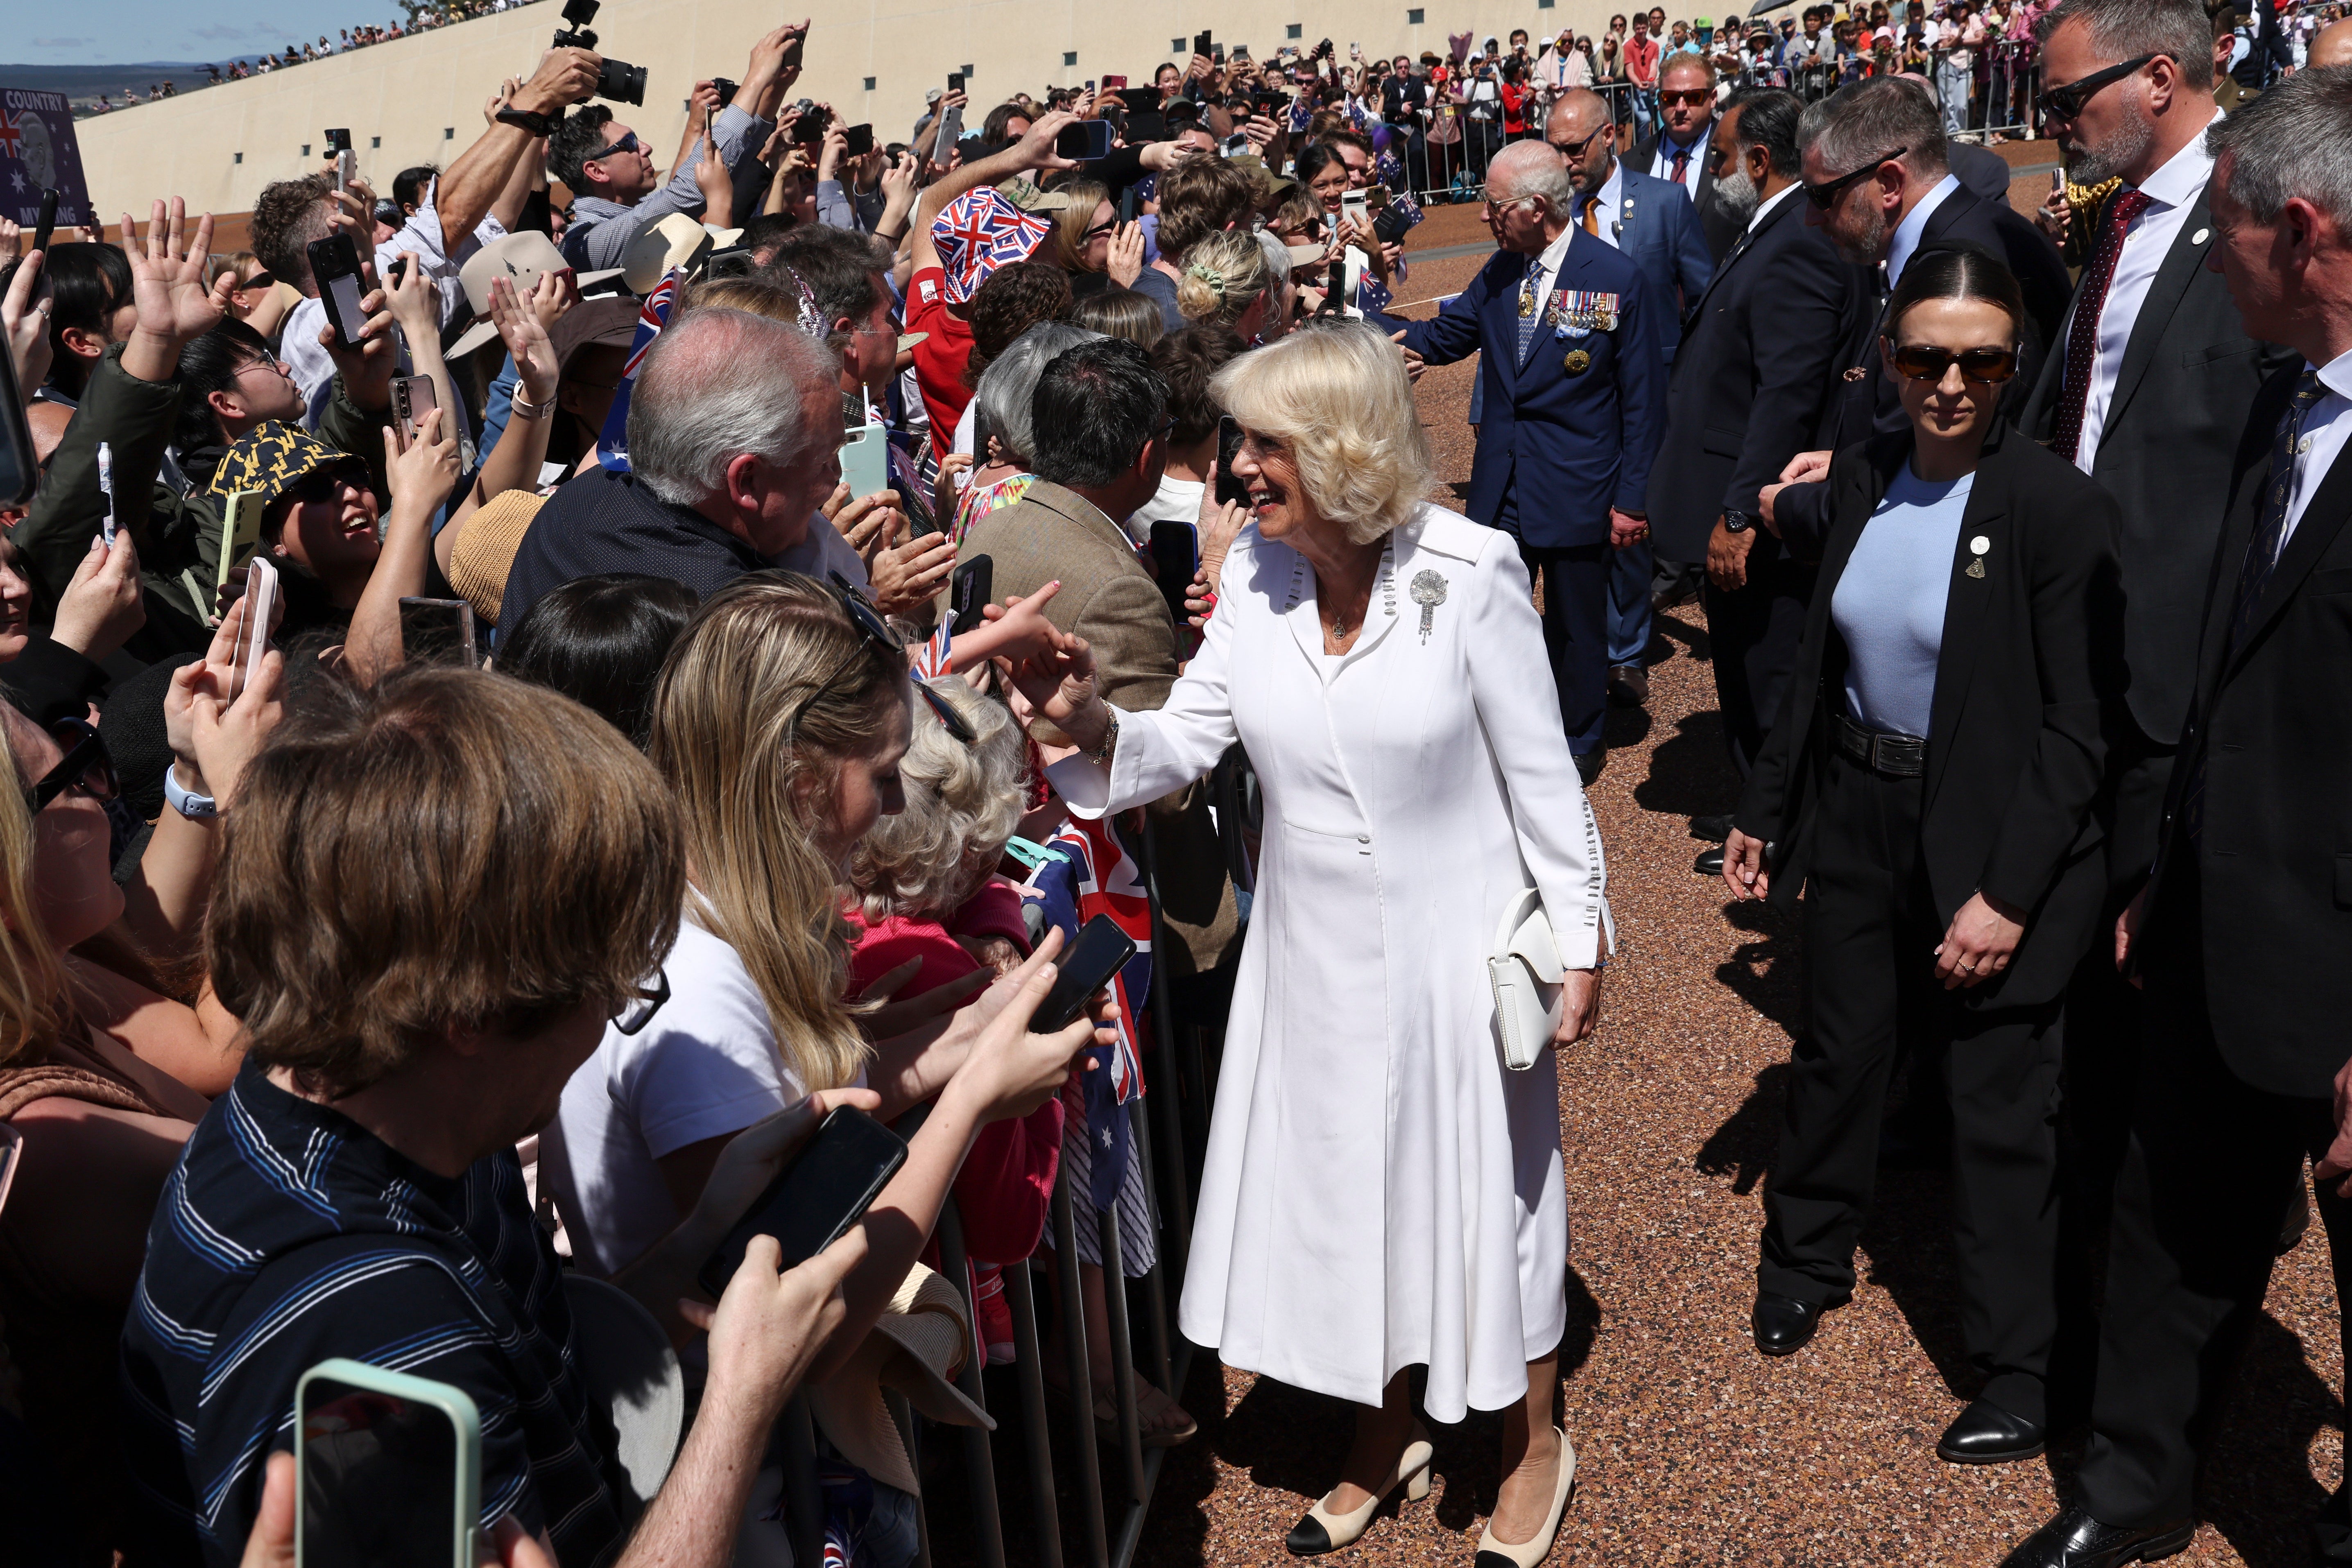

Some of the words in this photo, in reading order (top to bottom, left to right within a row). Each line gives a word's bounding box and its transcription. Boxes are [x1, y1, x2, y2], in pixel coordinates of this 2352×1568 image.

[6, 91, 62, 111] COUNTRY
[19, 207, 40, 224] MY
[55, 206, 77, 223] ING
